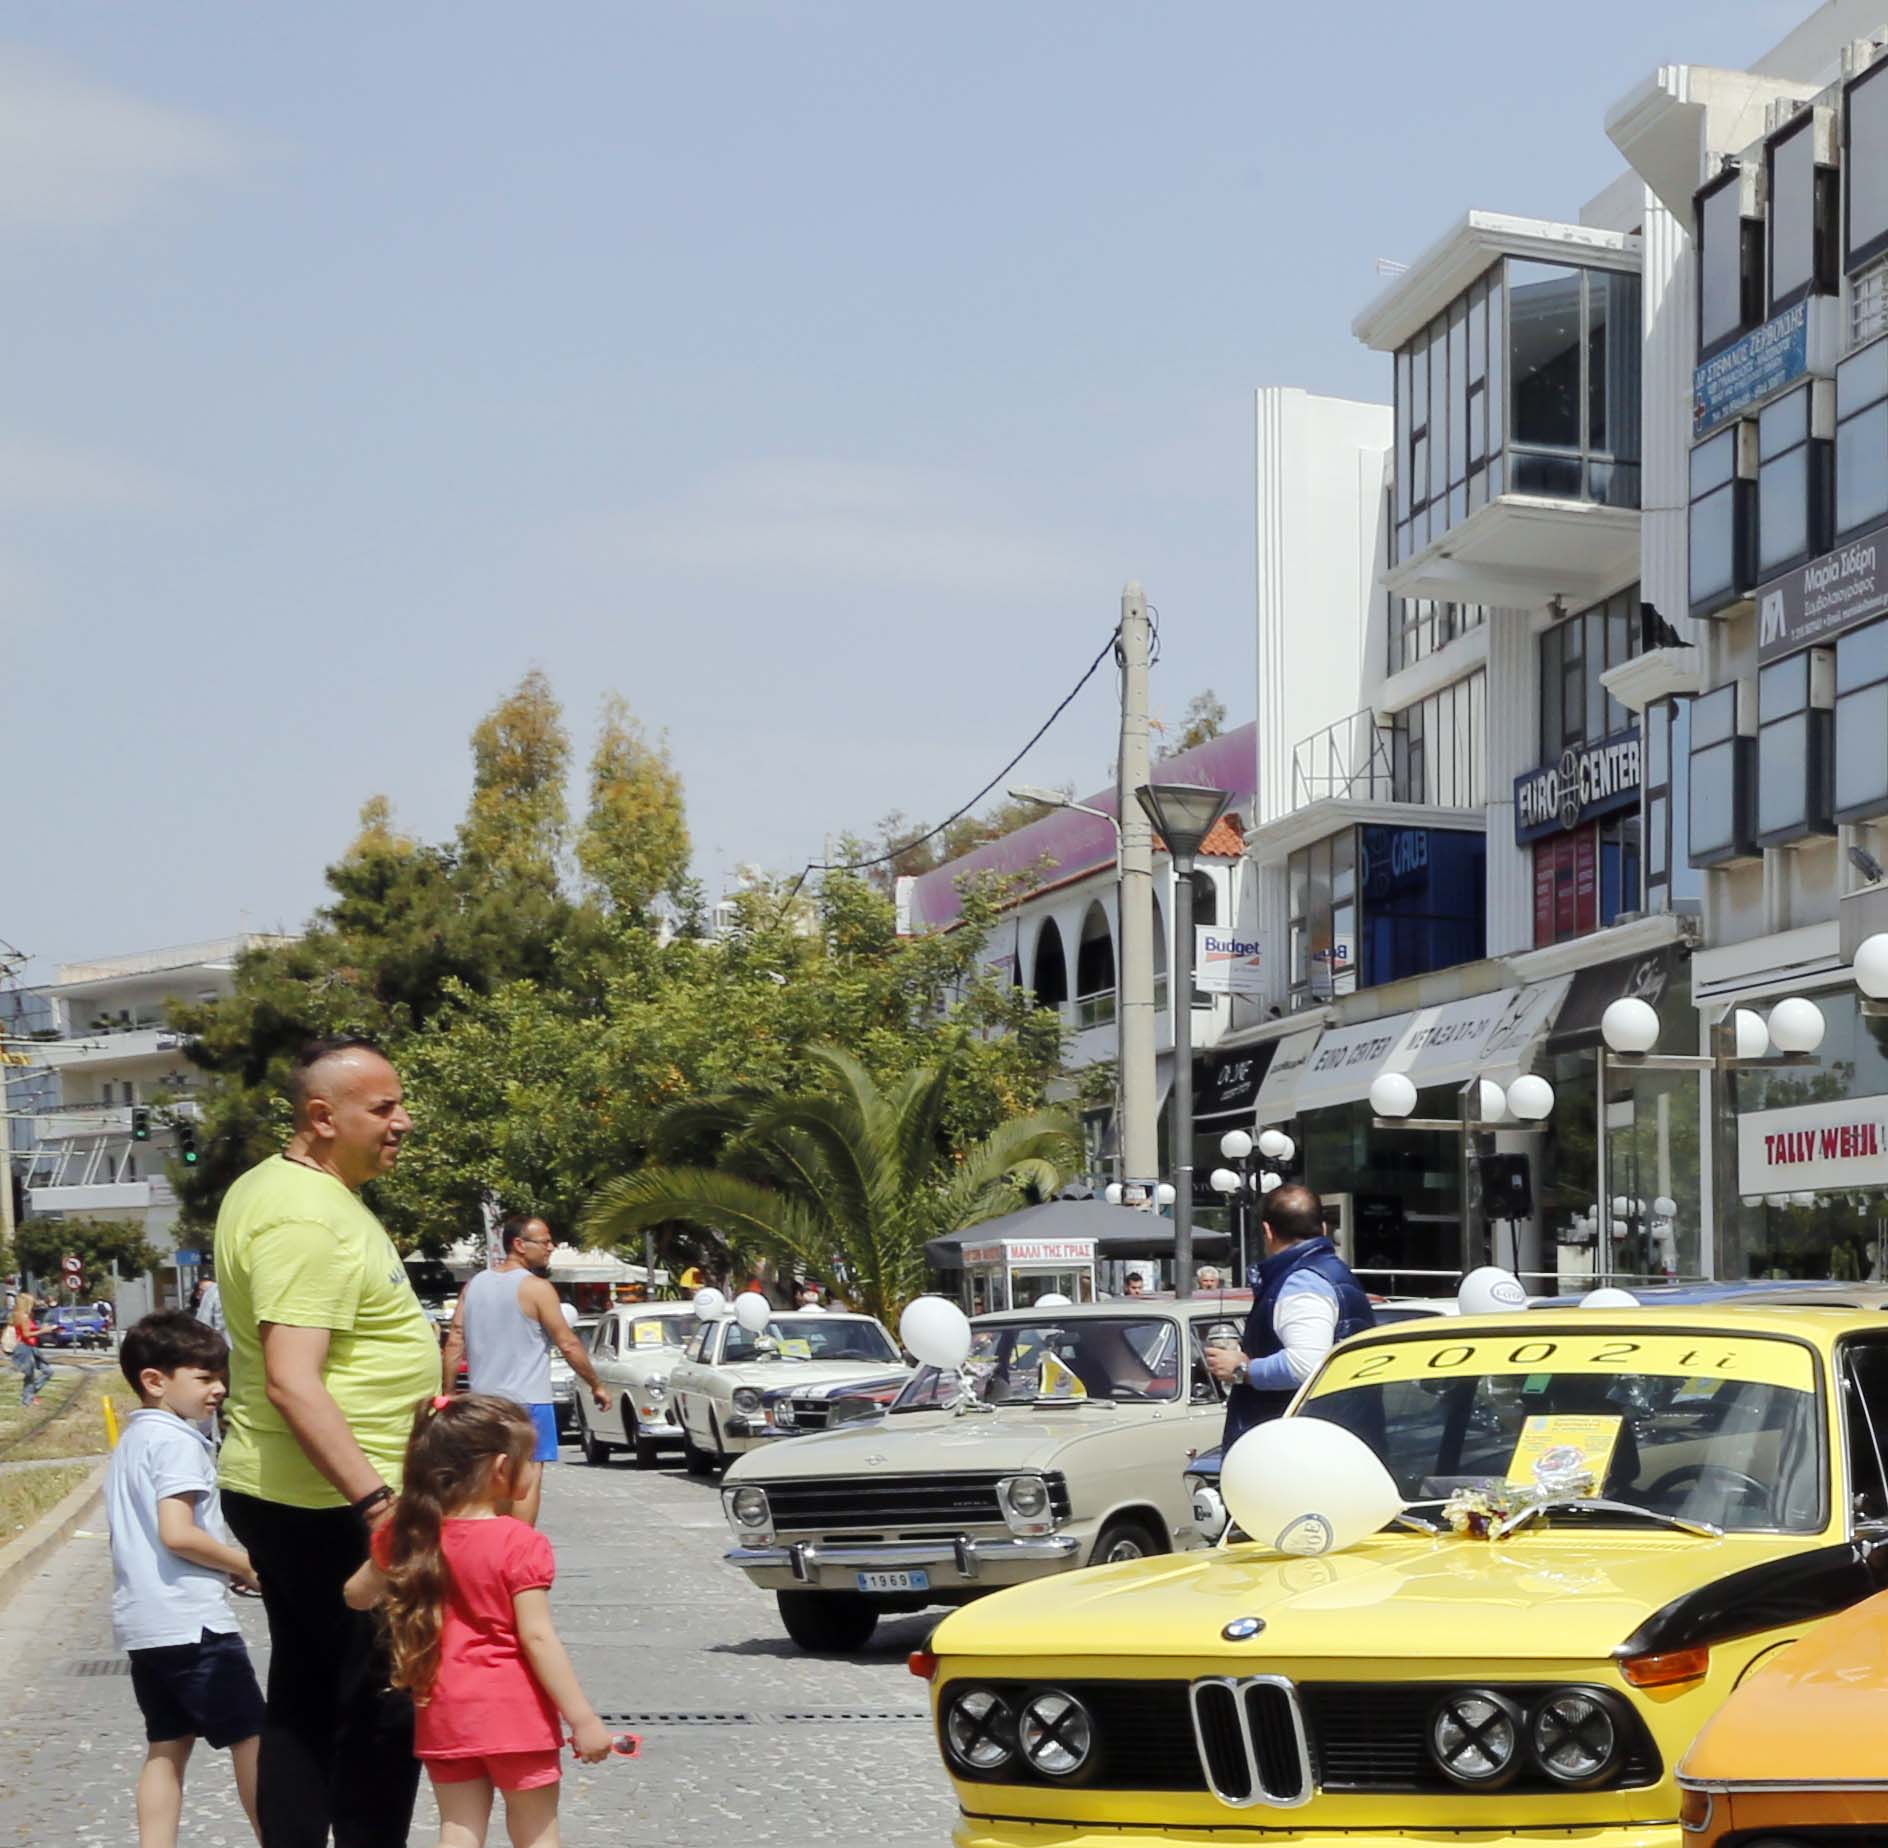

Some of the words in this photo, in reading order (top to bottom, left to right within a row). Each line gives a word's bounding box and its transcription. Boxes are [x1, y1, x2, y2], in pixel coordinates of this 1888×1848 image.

[1518, 769, 1559, 828] EURO
[1579, 740, 1641, 805] CENTER
[1204, 935, 1261, 958] Budget
[1764, 1129, 1816, 1166] TALLY
[1350, 1342, 1642, 1380] 2002
[1679, 1349, 1738, 1369] ti
[870, 1573, 907, 1587] 1969
